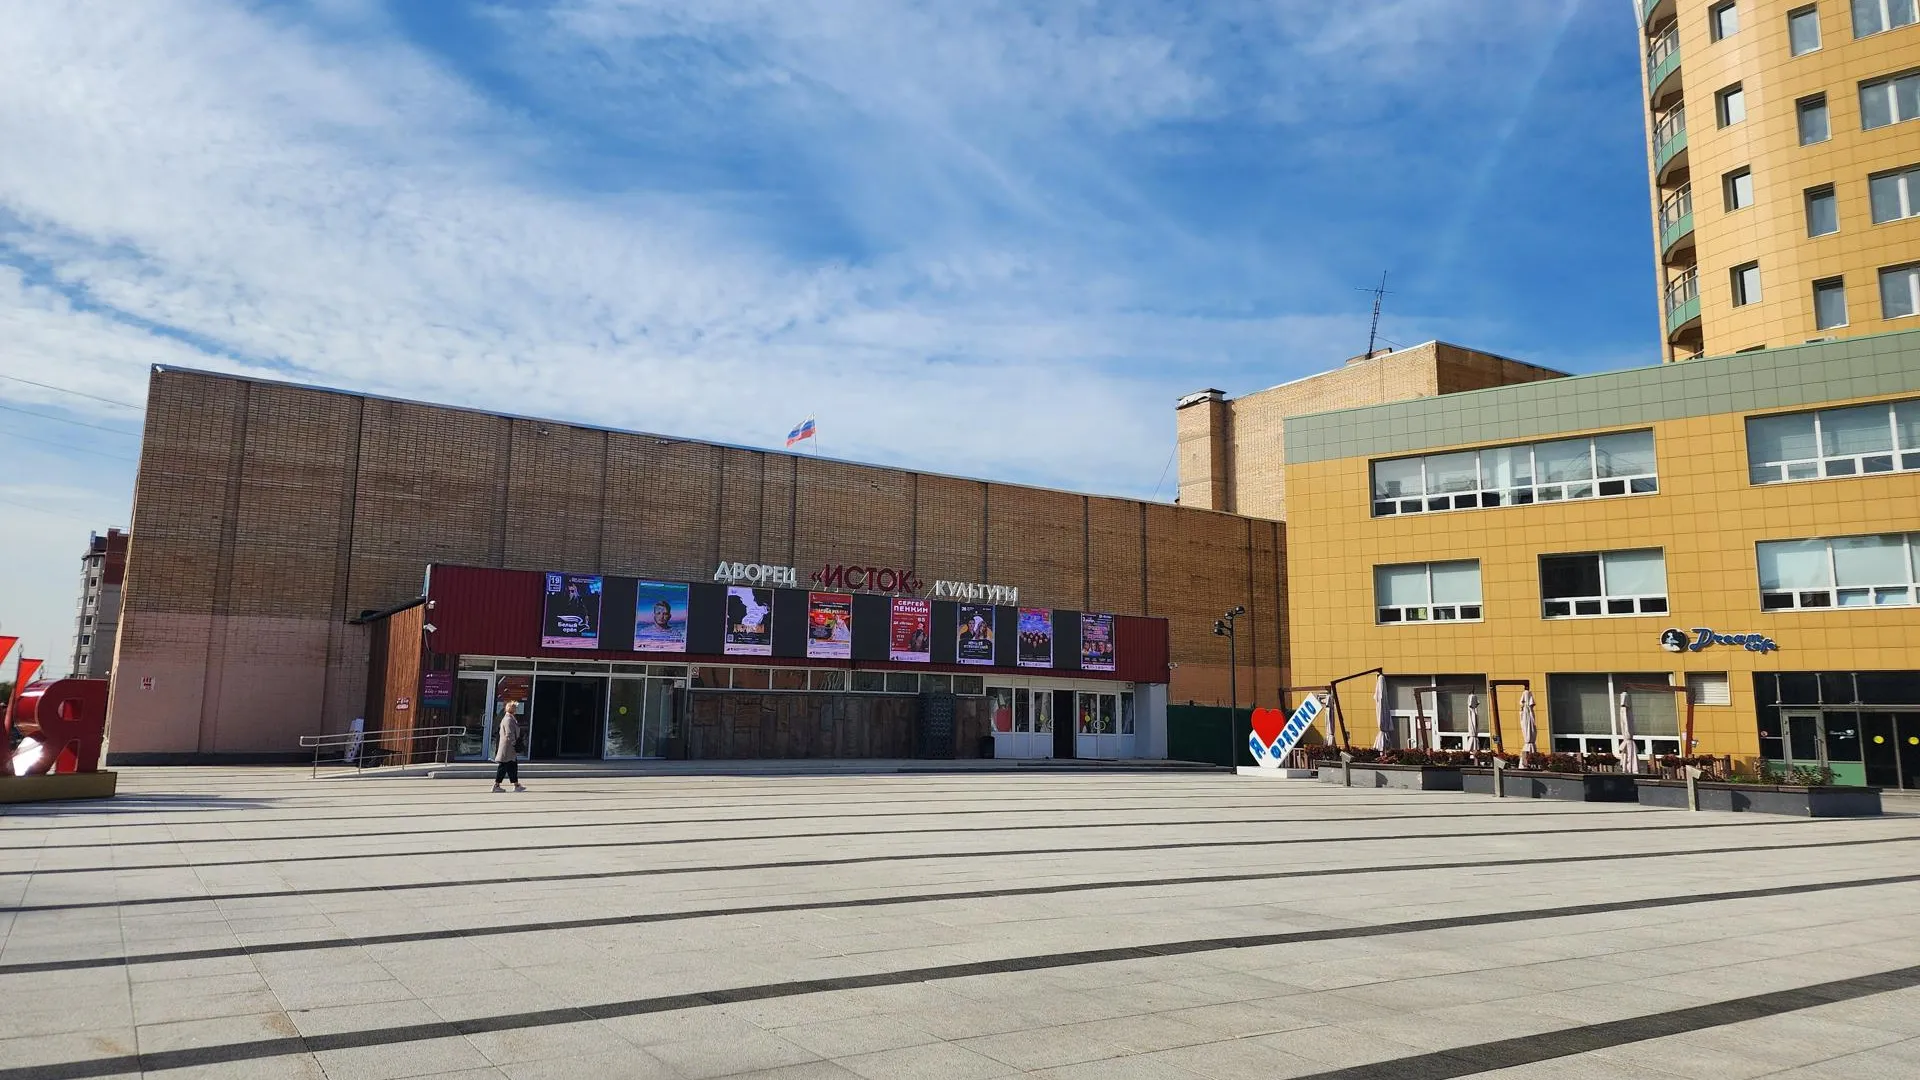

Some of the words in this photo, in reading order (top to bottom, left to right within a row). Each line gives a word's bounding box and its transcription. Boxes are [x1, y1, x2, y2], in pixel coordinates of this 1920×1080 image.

[713, 561, 797, 588] ДВОРЕЦ
[809, 563, 923, 594] «ИСТОК»
[934, 580, 1018, 603] КУЛЬТУРЫ
[893, 605, 929, 613] ПЕНКИН
[1688, 627, 1763, 652] Dream
[1249, 736, 1266, 759] Я
[1270, 700, 1317, 759] ФРЯЗИНО
